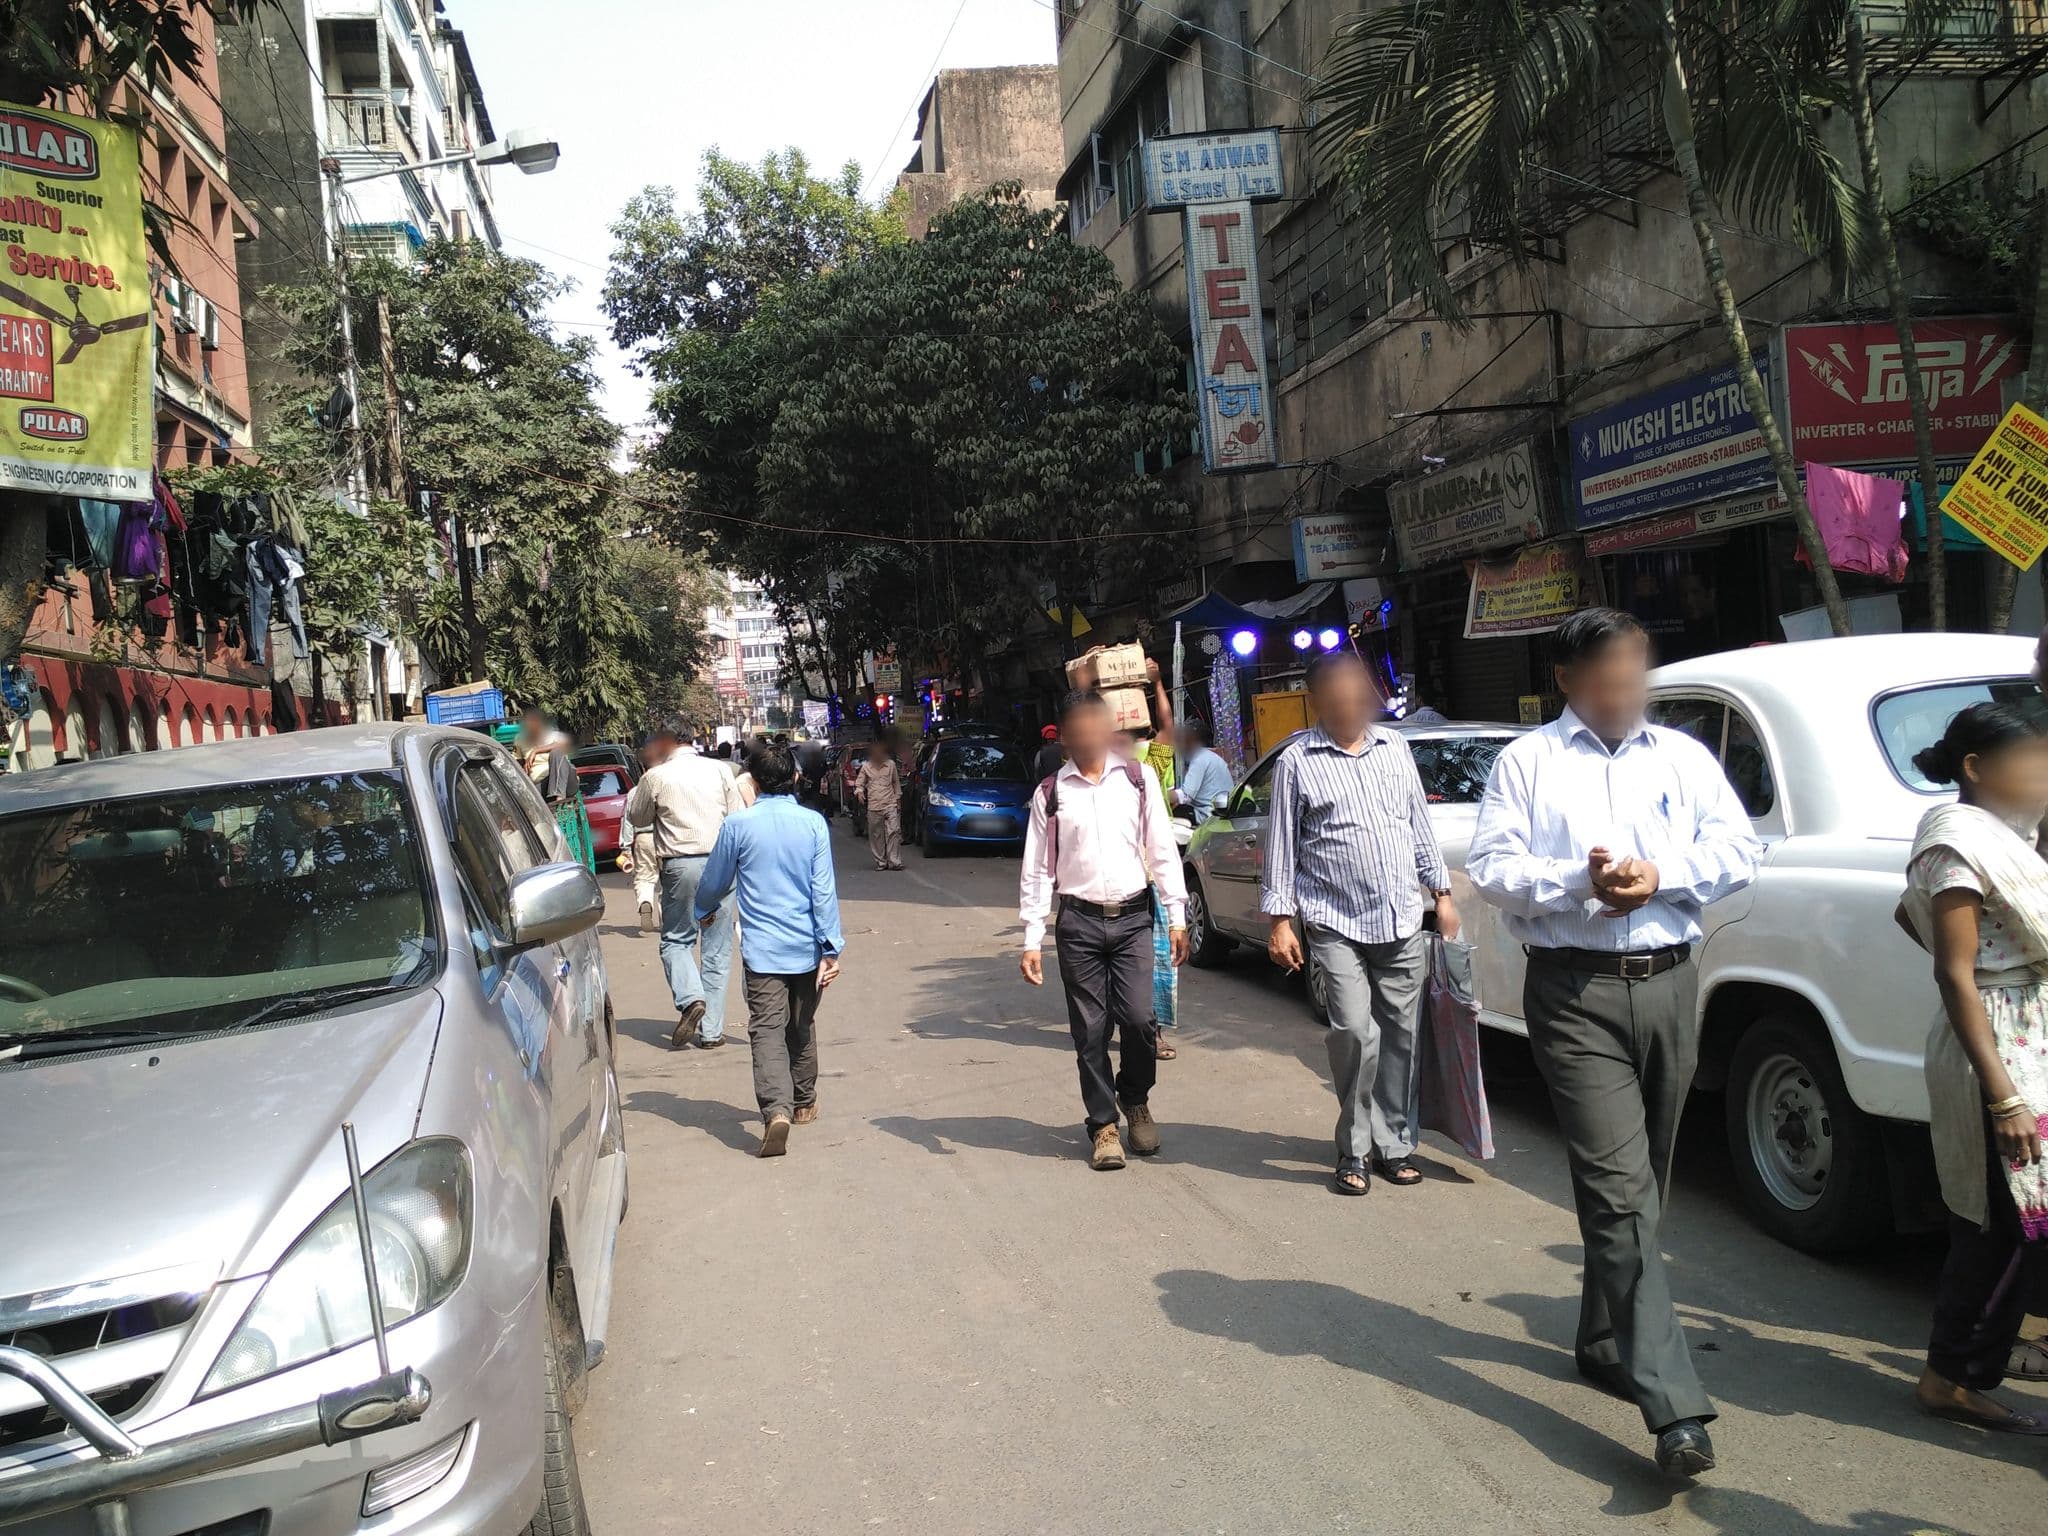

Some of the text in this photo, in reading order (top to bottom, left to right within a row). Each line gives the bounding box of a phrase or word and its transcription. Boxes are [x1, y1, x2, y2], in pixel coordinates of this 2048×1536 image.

[1199, 143, 1270, 171] ANWAR
[36, 181, 104, 209] Superior
[1199, 212, 1258, 375] TEA
[24, 412, 83, 434] POLAR
[1598, 408, 1666, 459] MUKESH
[1796, 422, 1866, 440] INVERTER
[1877, 416, 1944, 434] CHARER
[19, 441, 45, 452] Switch
[57, 446, 67, 454] to
[1663, 438, 1686, 454] POWER
[2001, 428, 2026, 450] FANCY
[2, 463, 138, 489] ENGINEERING CORPORATION
[1584, 477, 1622, 498] INVERTERS
[1623, 465, 1664, 486] BATTERIES
[1666, 451, 1710, 474] CHARGERS
[1971, 463, 2008, 493] AJIT
[1982, 449, 2018, 479] ANIL
[2015, 470, 2048, 502] KUM
[1725, 502, 1764, 516] MICROTEK
